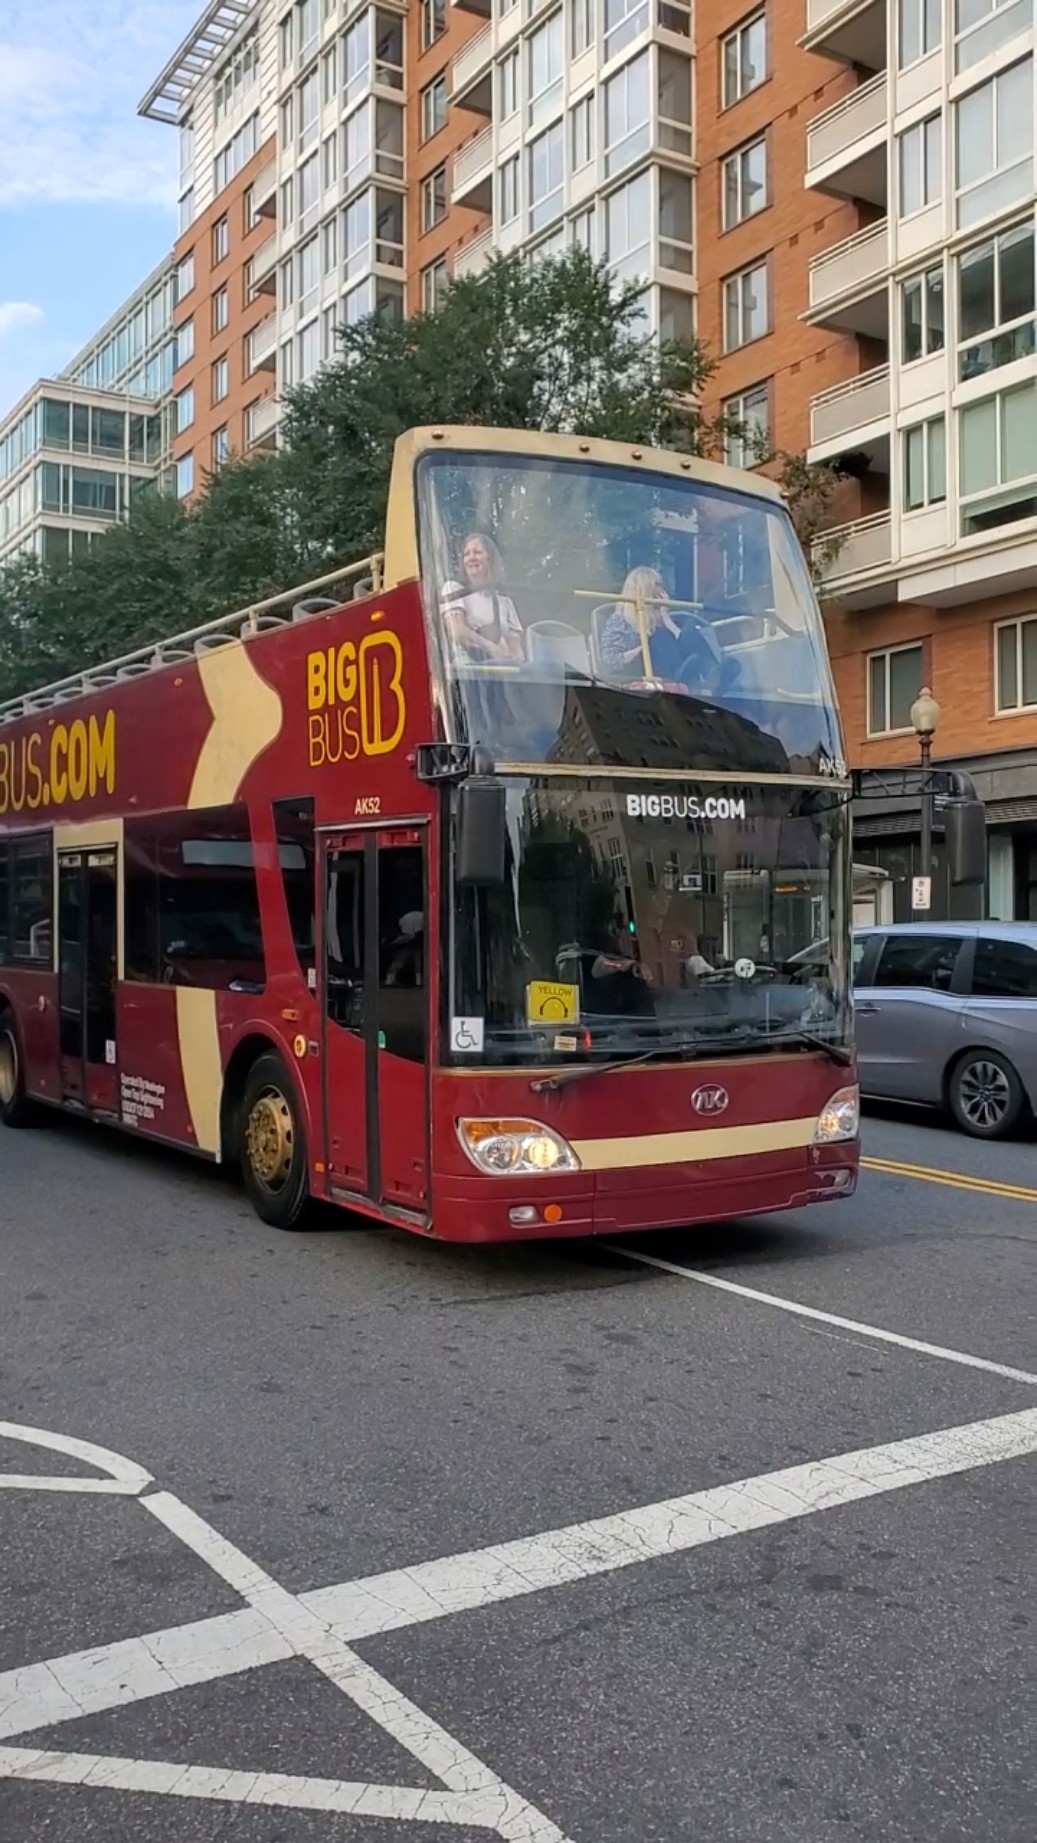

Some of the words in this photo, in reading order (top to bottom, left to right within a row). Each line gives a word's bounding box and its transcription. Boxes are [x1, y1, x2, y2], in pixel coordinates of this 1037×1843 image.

[308, 642, 357, 710] BIG
[309, 706, 360, 766] BUS
[354, 797, 381, 815] AK52
[626, 794, 746, 820] BIGBUS.COM
[538, 985, 573, 997] YELLOW
